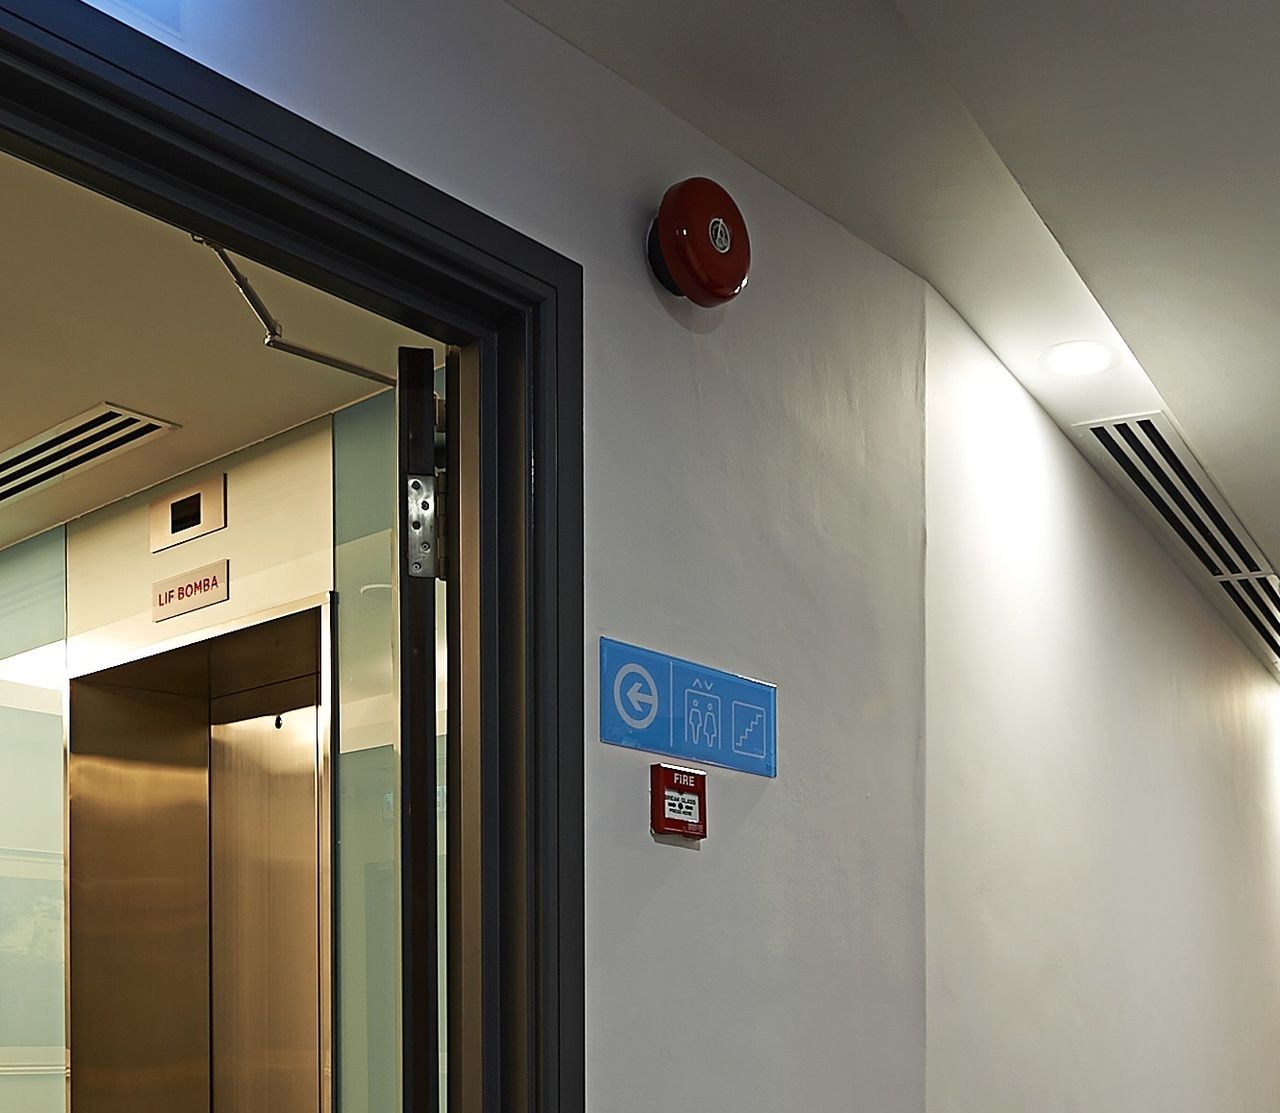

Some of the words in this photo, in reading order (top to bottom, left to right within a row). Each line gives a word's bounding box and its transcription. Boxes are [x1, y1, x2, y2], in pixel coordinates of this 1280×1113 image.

[158, 589, 174, 607] LIF
[177, 575, 219, 601] BOMBA
[673, 772, 695, 787] FIRE
